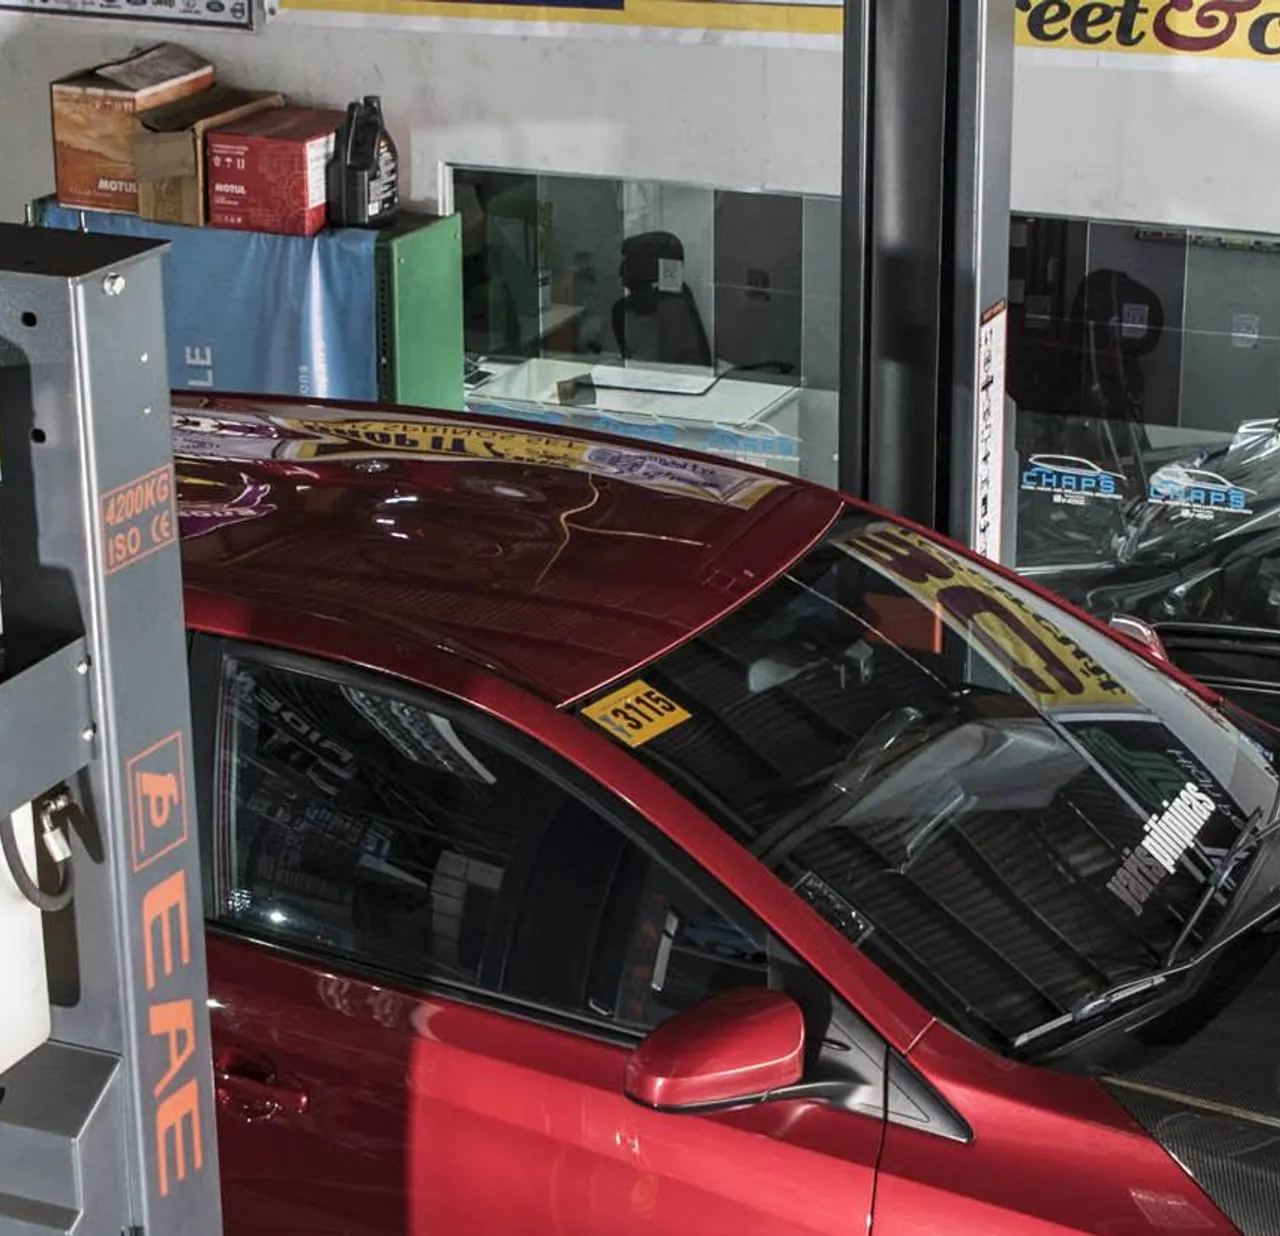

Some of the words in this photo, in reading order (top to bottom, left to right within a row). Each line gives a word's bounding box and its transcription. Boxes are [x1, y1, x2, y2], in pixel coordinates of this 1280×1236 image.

[215, 183, 246, 196] MOTUL
[105, 472, 170, 527] 4200KG
[1023, 467, 1117, 494] CHAPS
[107, 525, 142, 567] ISO
[611, 690, 677, 730] 3115
[141, 869, 204, 1199] EAE
